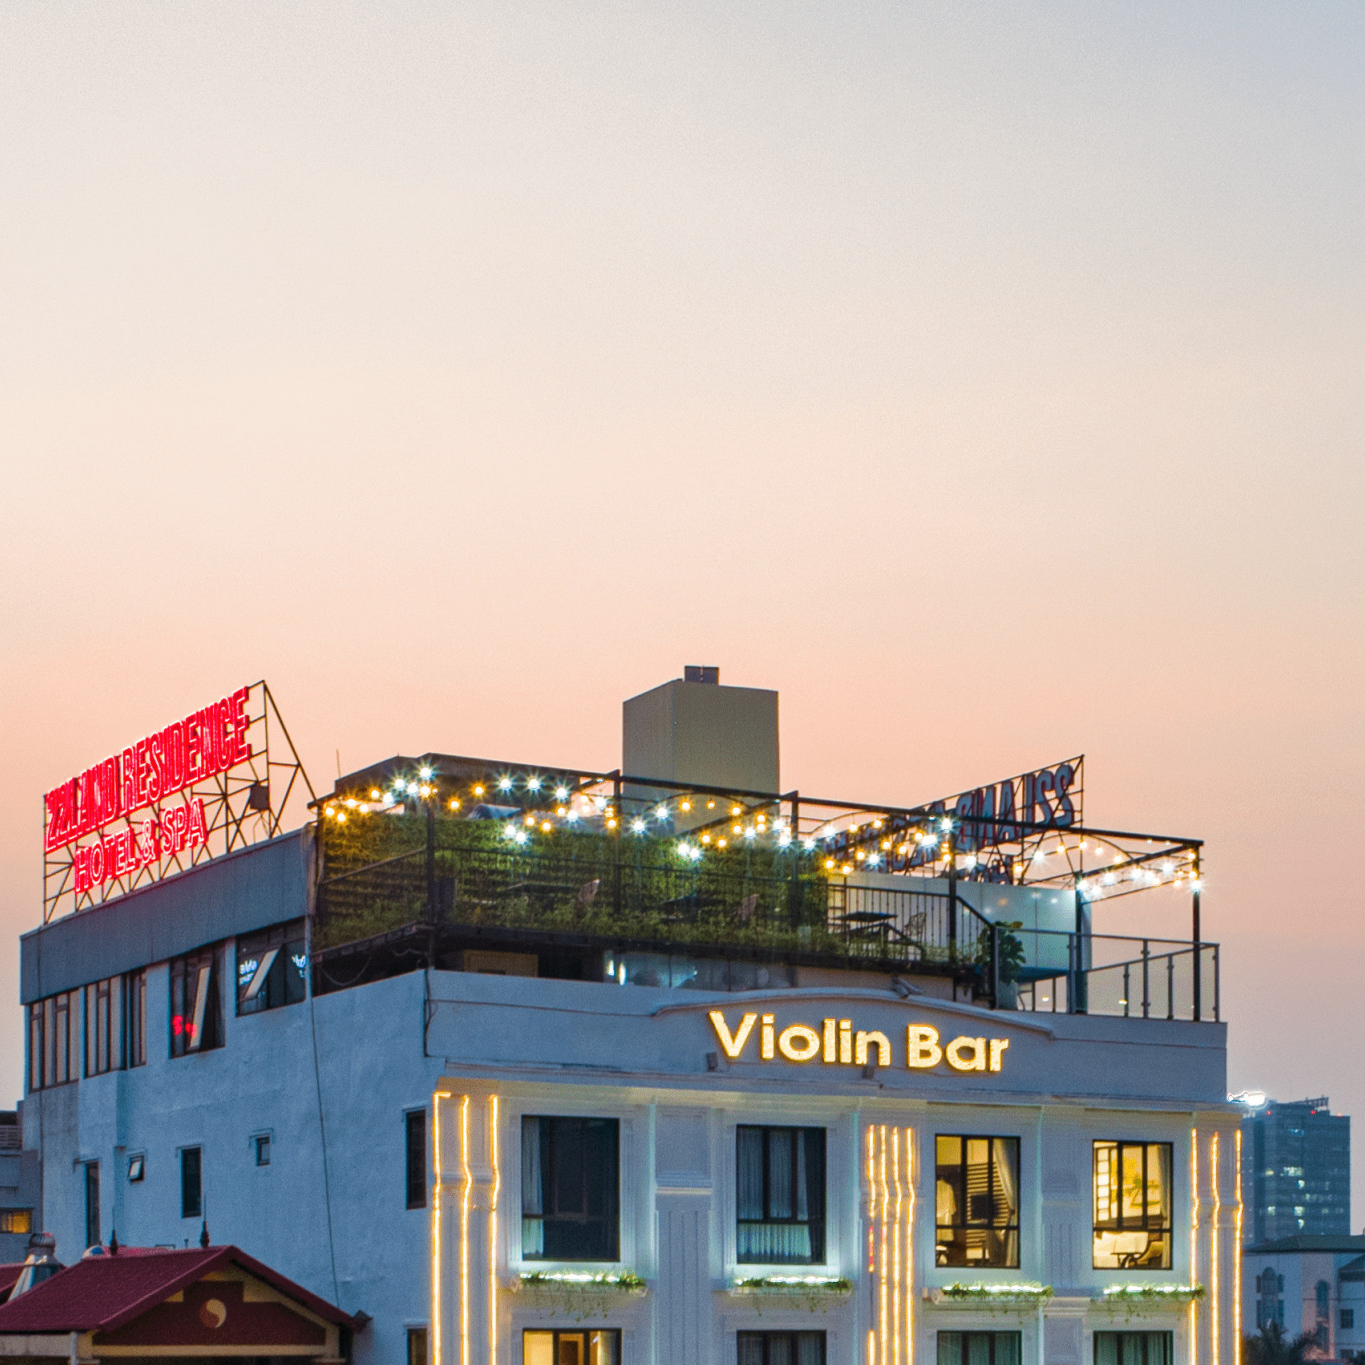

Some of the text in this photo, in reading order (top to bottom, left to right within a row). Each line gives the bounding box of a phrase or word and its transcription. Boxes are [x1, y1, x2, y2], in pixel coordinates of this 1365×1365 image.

[119, 686, 252, 817] RESIDENCE
[74, 797, 210, 894] HOTEL & SPA
[708, 1010, 1009, 1073] Violin Bar
